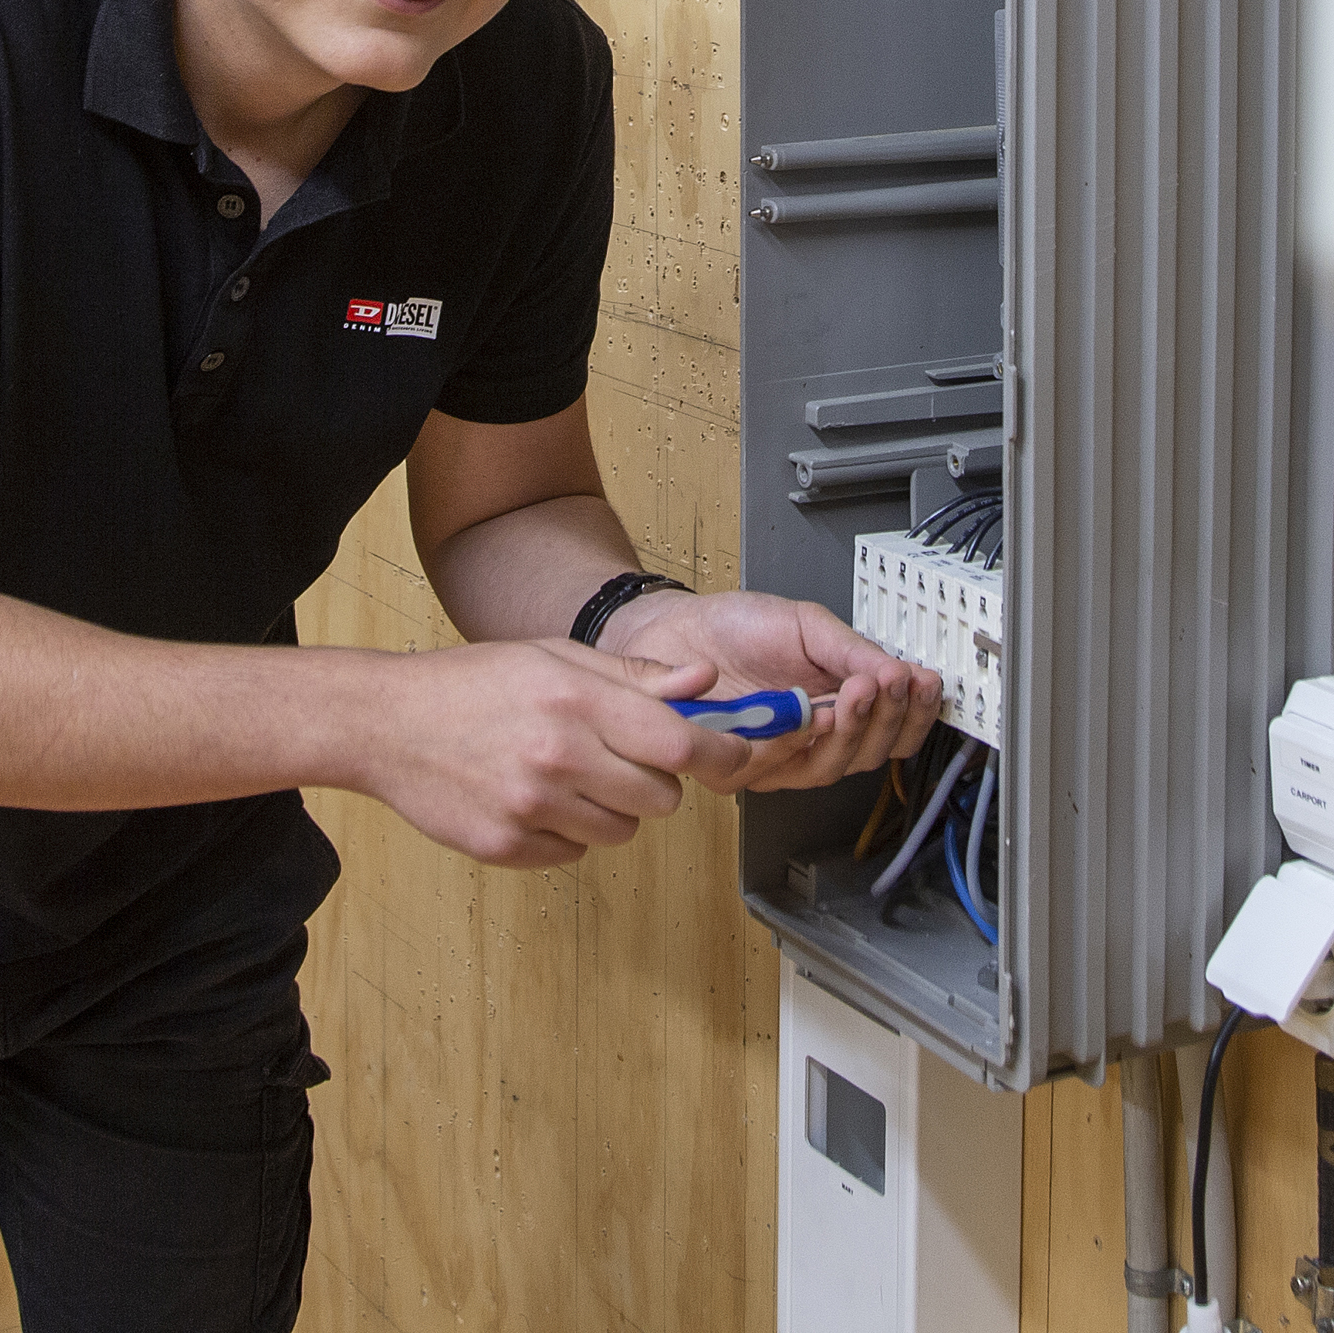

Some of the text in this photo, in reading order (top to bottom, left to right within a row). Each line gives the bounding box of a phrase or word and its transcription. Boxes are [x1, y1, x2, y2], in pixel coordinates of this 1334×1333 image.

[384, 302, 434, 328] DIESEL
[343, 322, 381, 333] DENIM
[1300, 757, 1320, 773] TIMER
[1290, 787, 1327, 809] CARPORT
